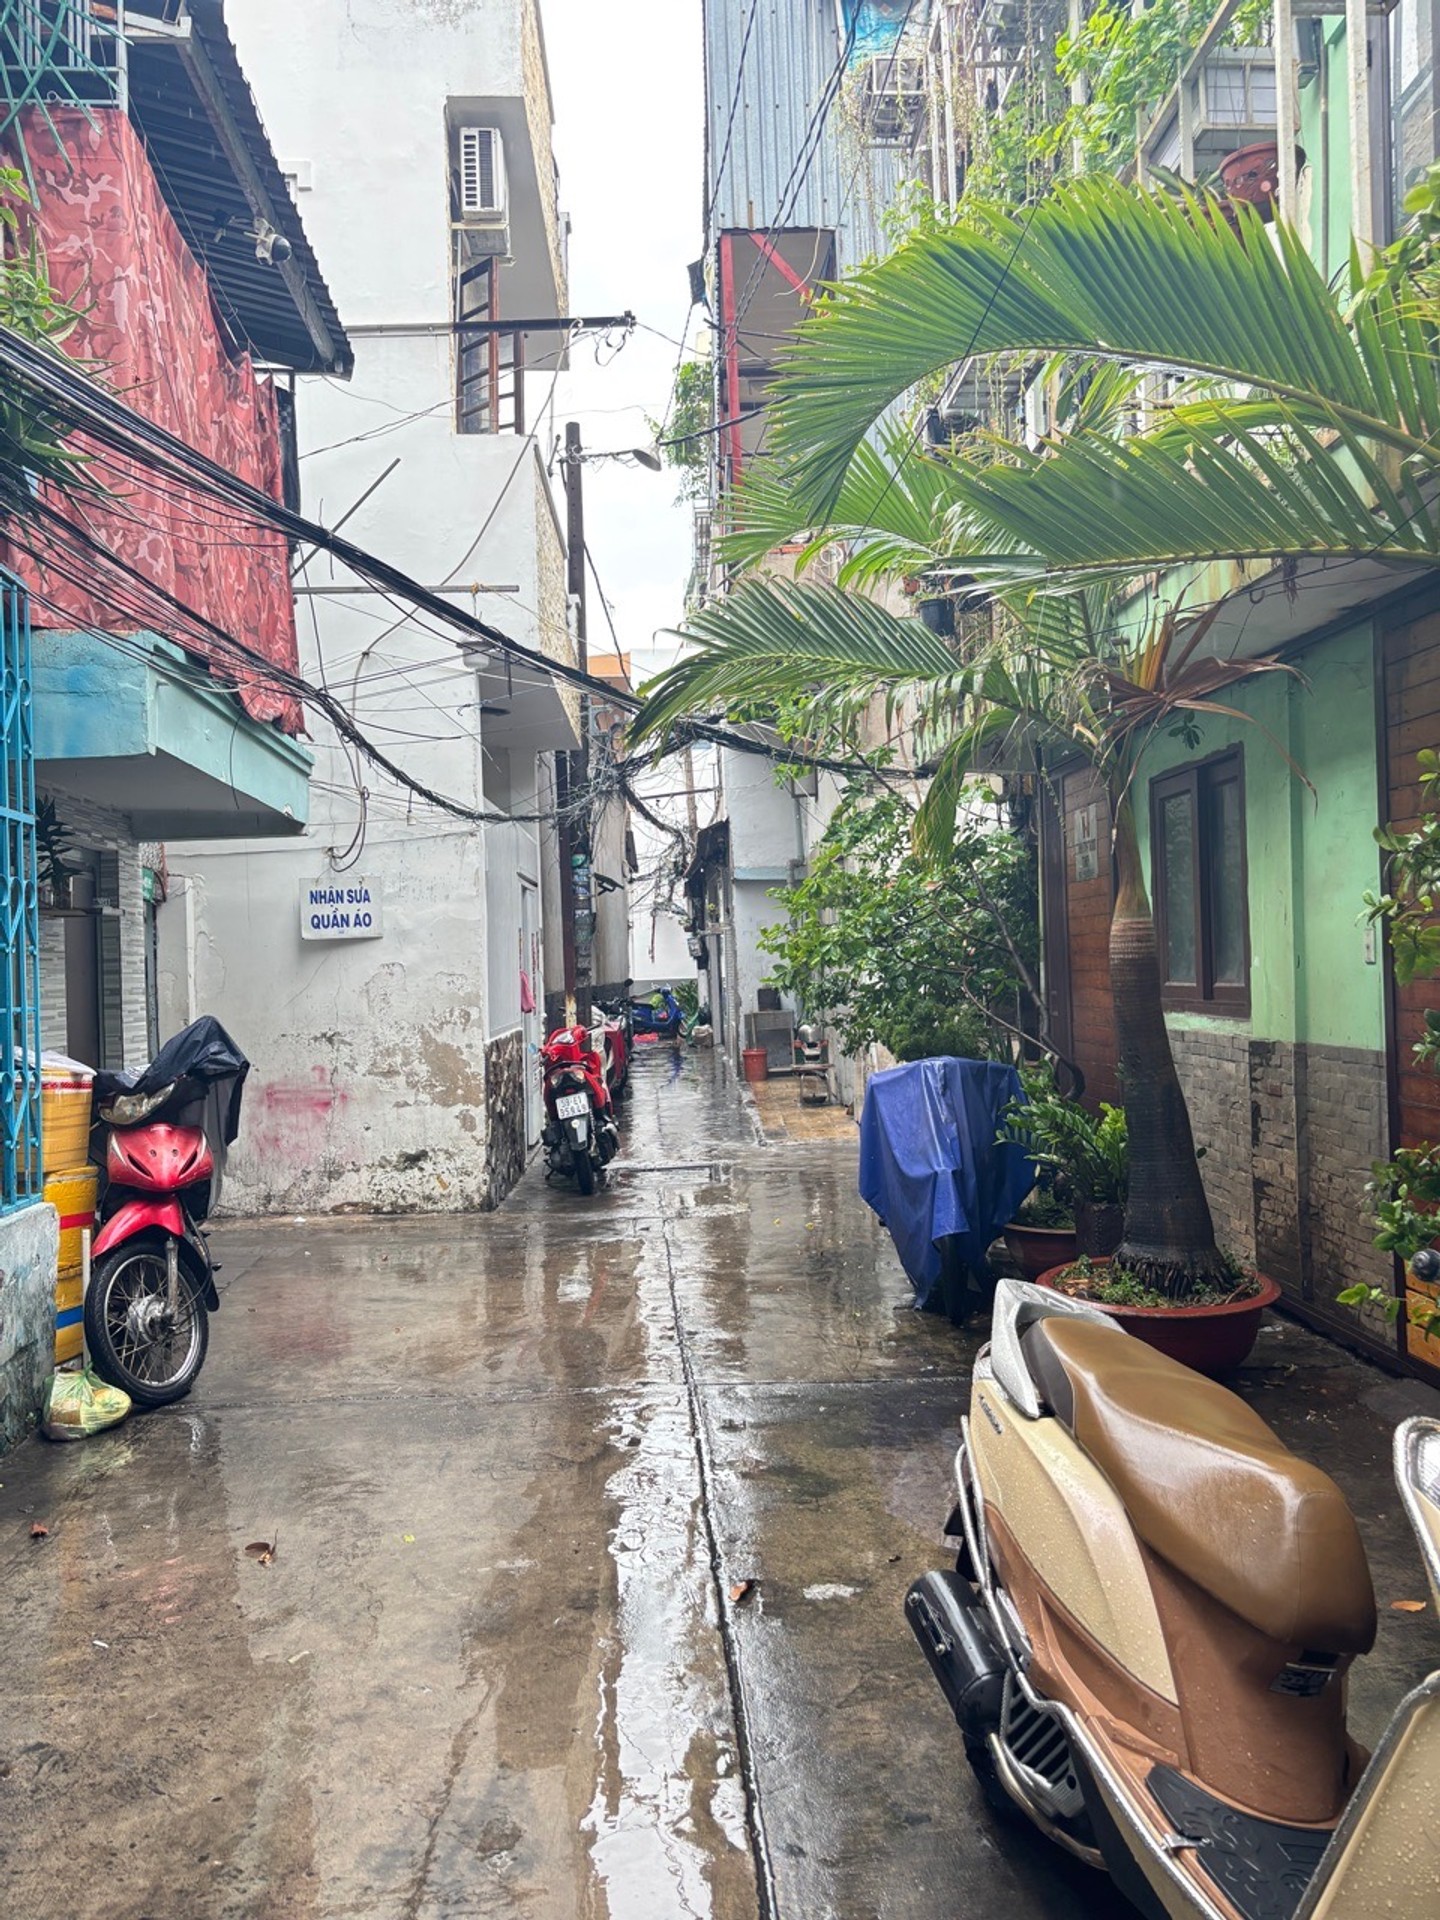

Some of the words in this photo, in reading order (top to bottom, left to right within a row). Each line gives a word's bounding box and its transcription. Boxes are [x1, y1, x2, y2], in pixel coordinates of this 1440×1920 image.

[309, 885, 344, 907] NHẬN
[346, 881, 371, 904] SỬA
[310, 907, 350, 930] QUẦN
[353, 908, 372, 928] ÁO
